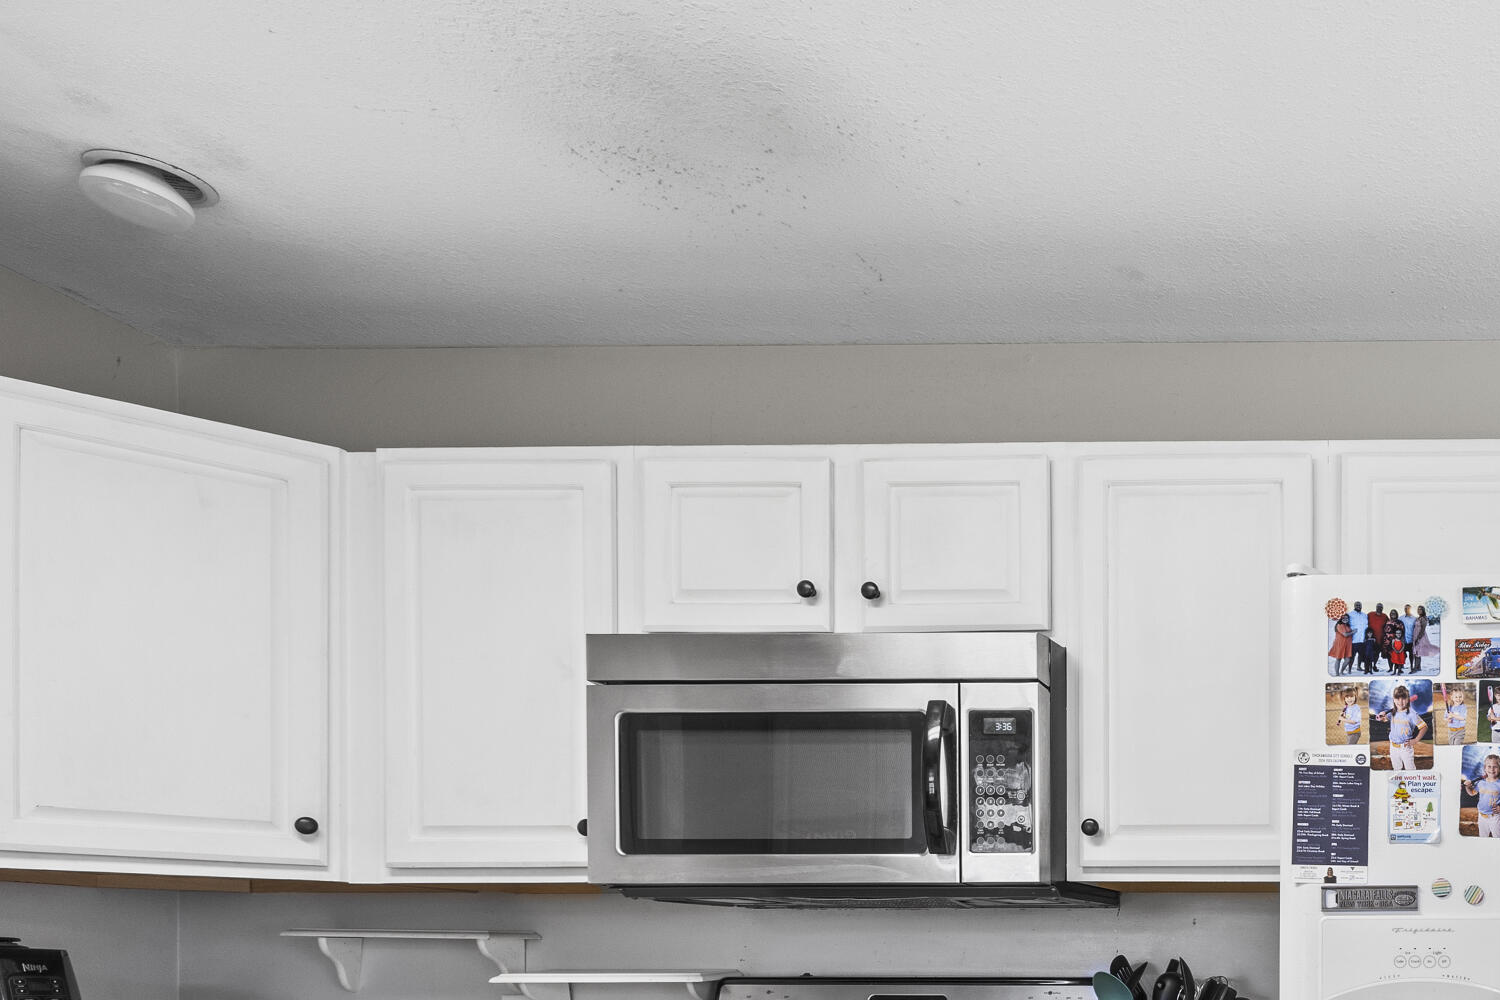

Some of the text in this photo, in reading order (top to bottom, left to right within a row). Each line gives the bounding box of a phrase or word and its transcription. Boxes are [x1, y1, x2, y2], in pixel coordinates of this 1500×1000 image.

[995, 722, 1012, 731] 3:36
[1338, 889, 1393, 900] NIAGARA FALLS
[22, 963, 48, 973] NINJA
